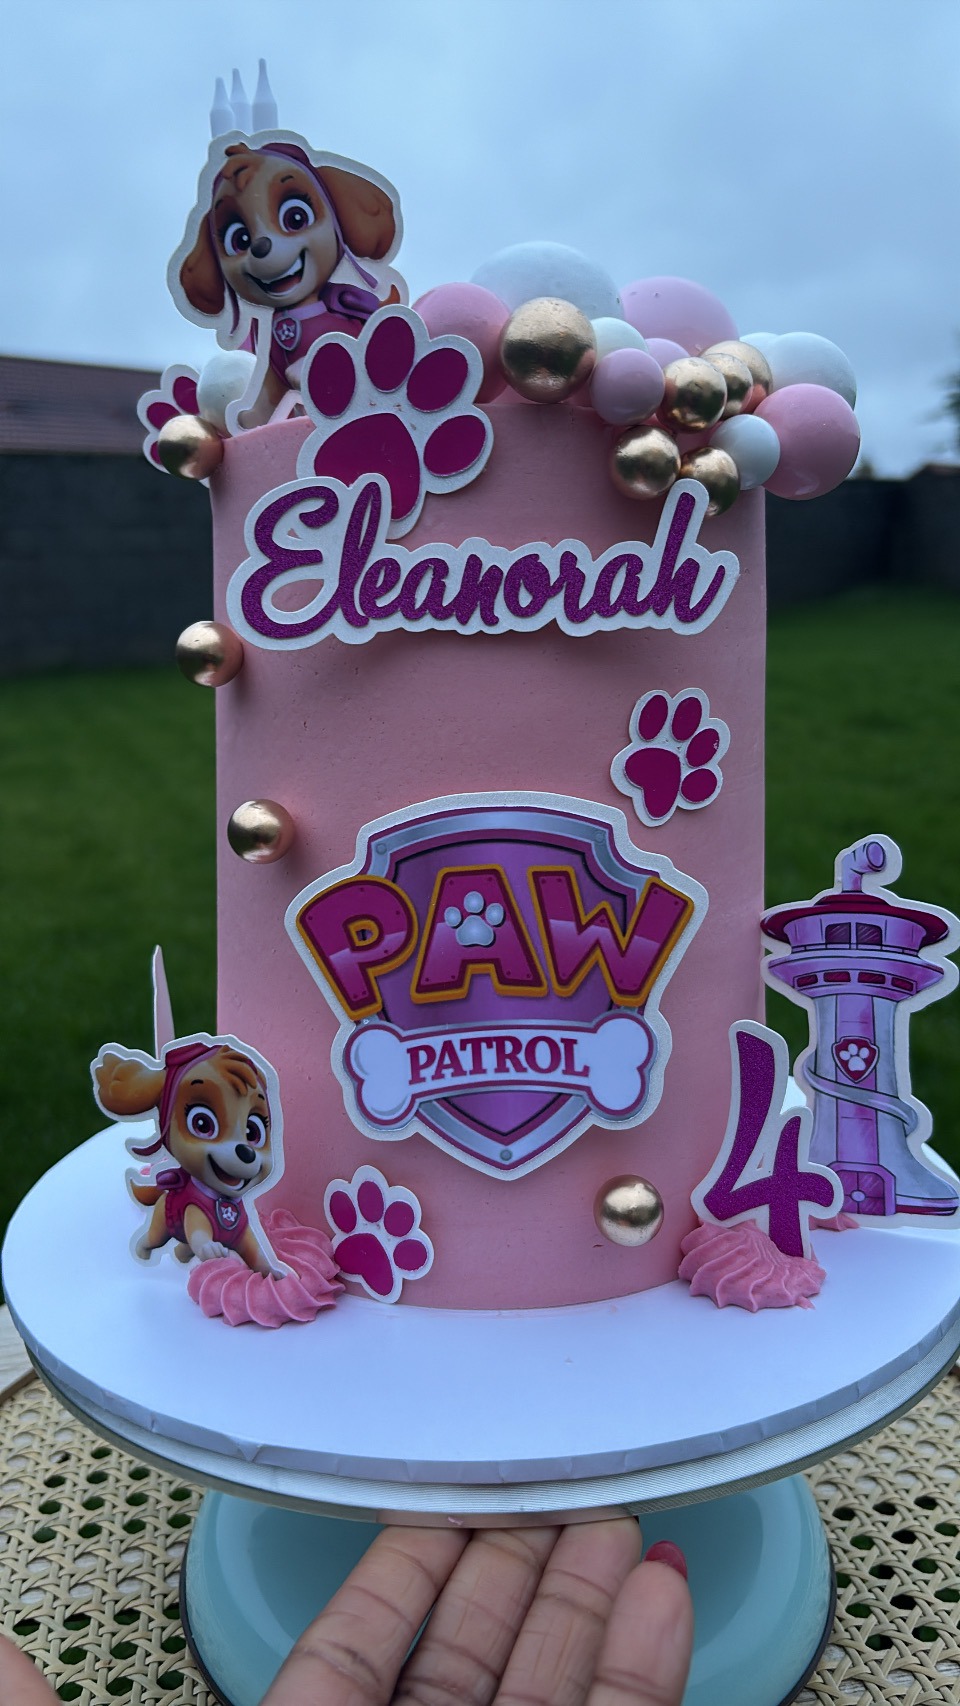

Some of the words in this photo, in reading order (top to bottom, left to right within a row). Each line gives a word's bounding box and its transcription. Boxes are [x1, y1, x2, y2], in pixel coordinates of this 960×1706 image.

[241, 481, 725, 639] Eleanorah
[296, 864, 694, 1021] PAW
[406, 1035, 590, 1085] PATROL
[703, 1030, 835, 1257] 4
